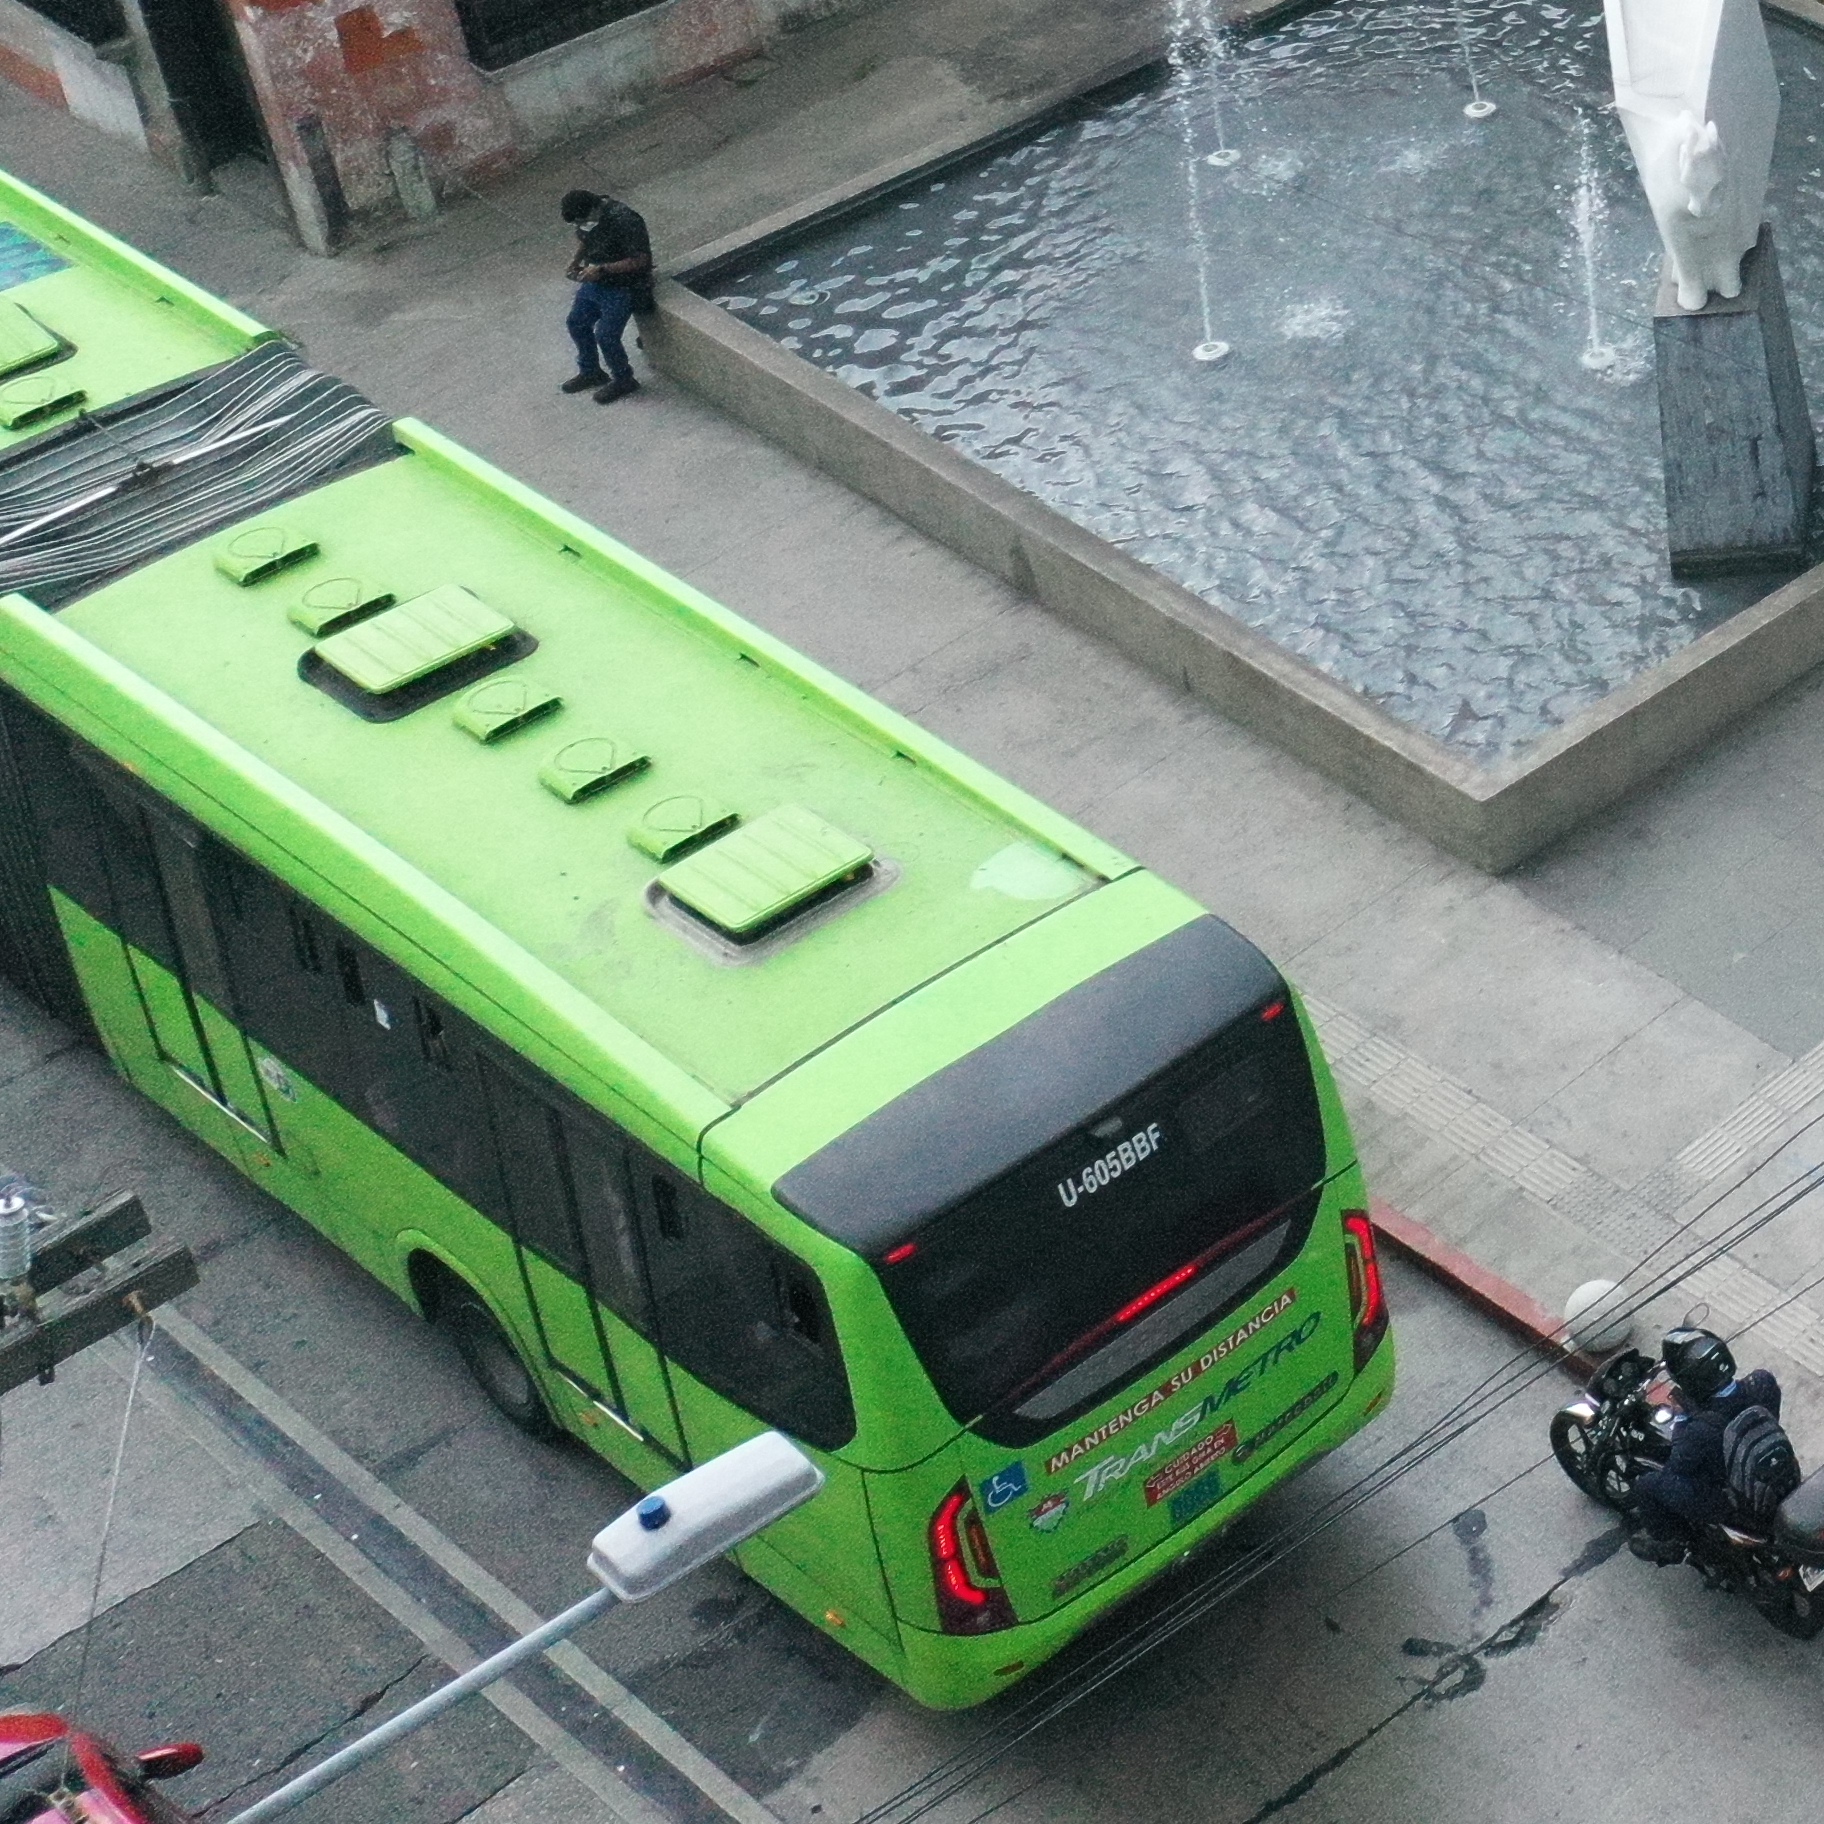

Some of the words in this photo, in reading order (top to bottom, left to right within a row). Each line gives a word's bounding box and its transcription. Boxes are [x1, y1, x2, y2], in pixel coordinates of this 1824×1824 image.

[1057, 1122, 1160, 1207] U-605BBF
[1050, 1390, 1165, 1473] MANTENGA
[1170, 1367, 1192, 1393] SU
[1200, 1294, 1292, 1371] DISTANCIA
[1165, 1436, 1213, 1473] CUIDADO
